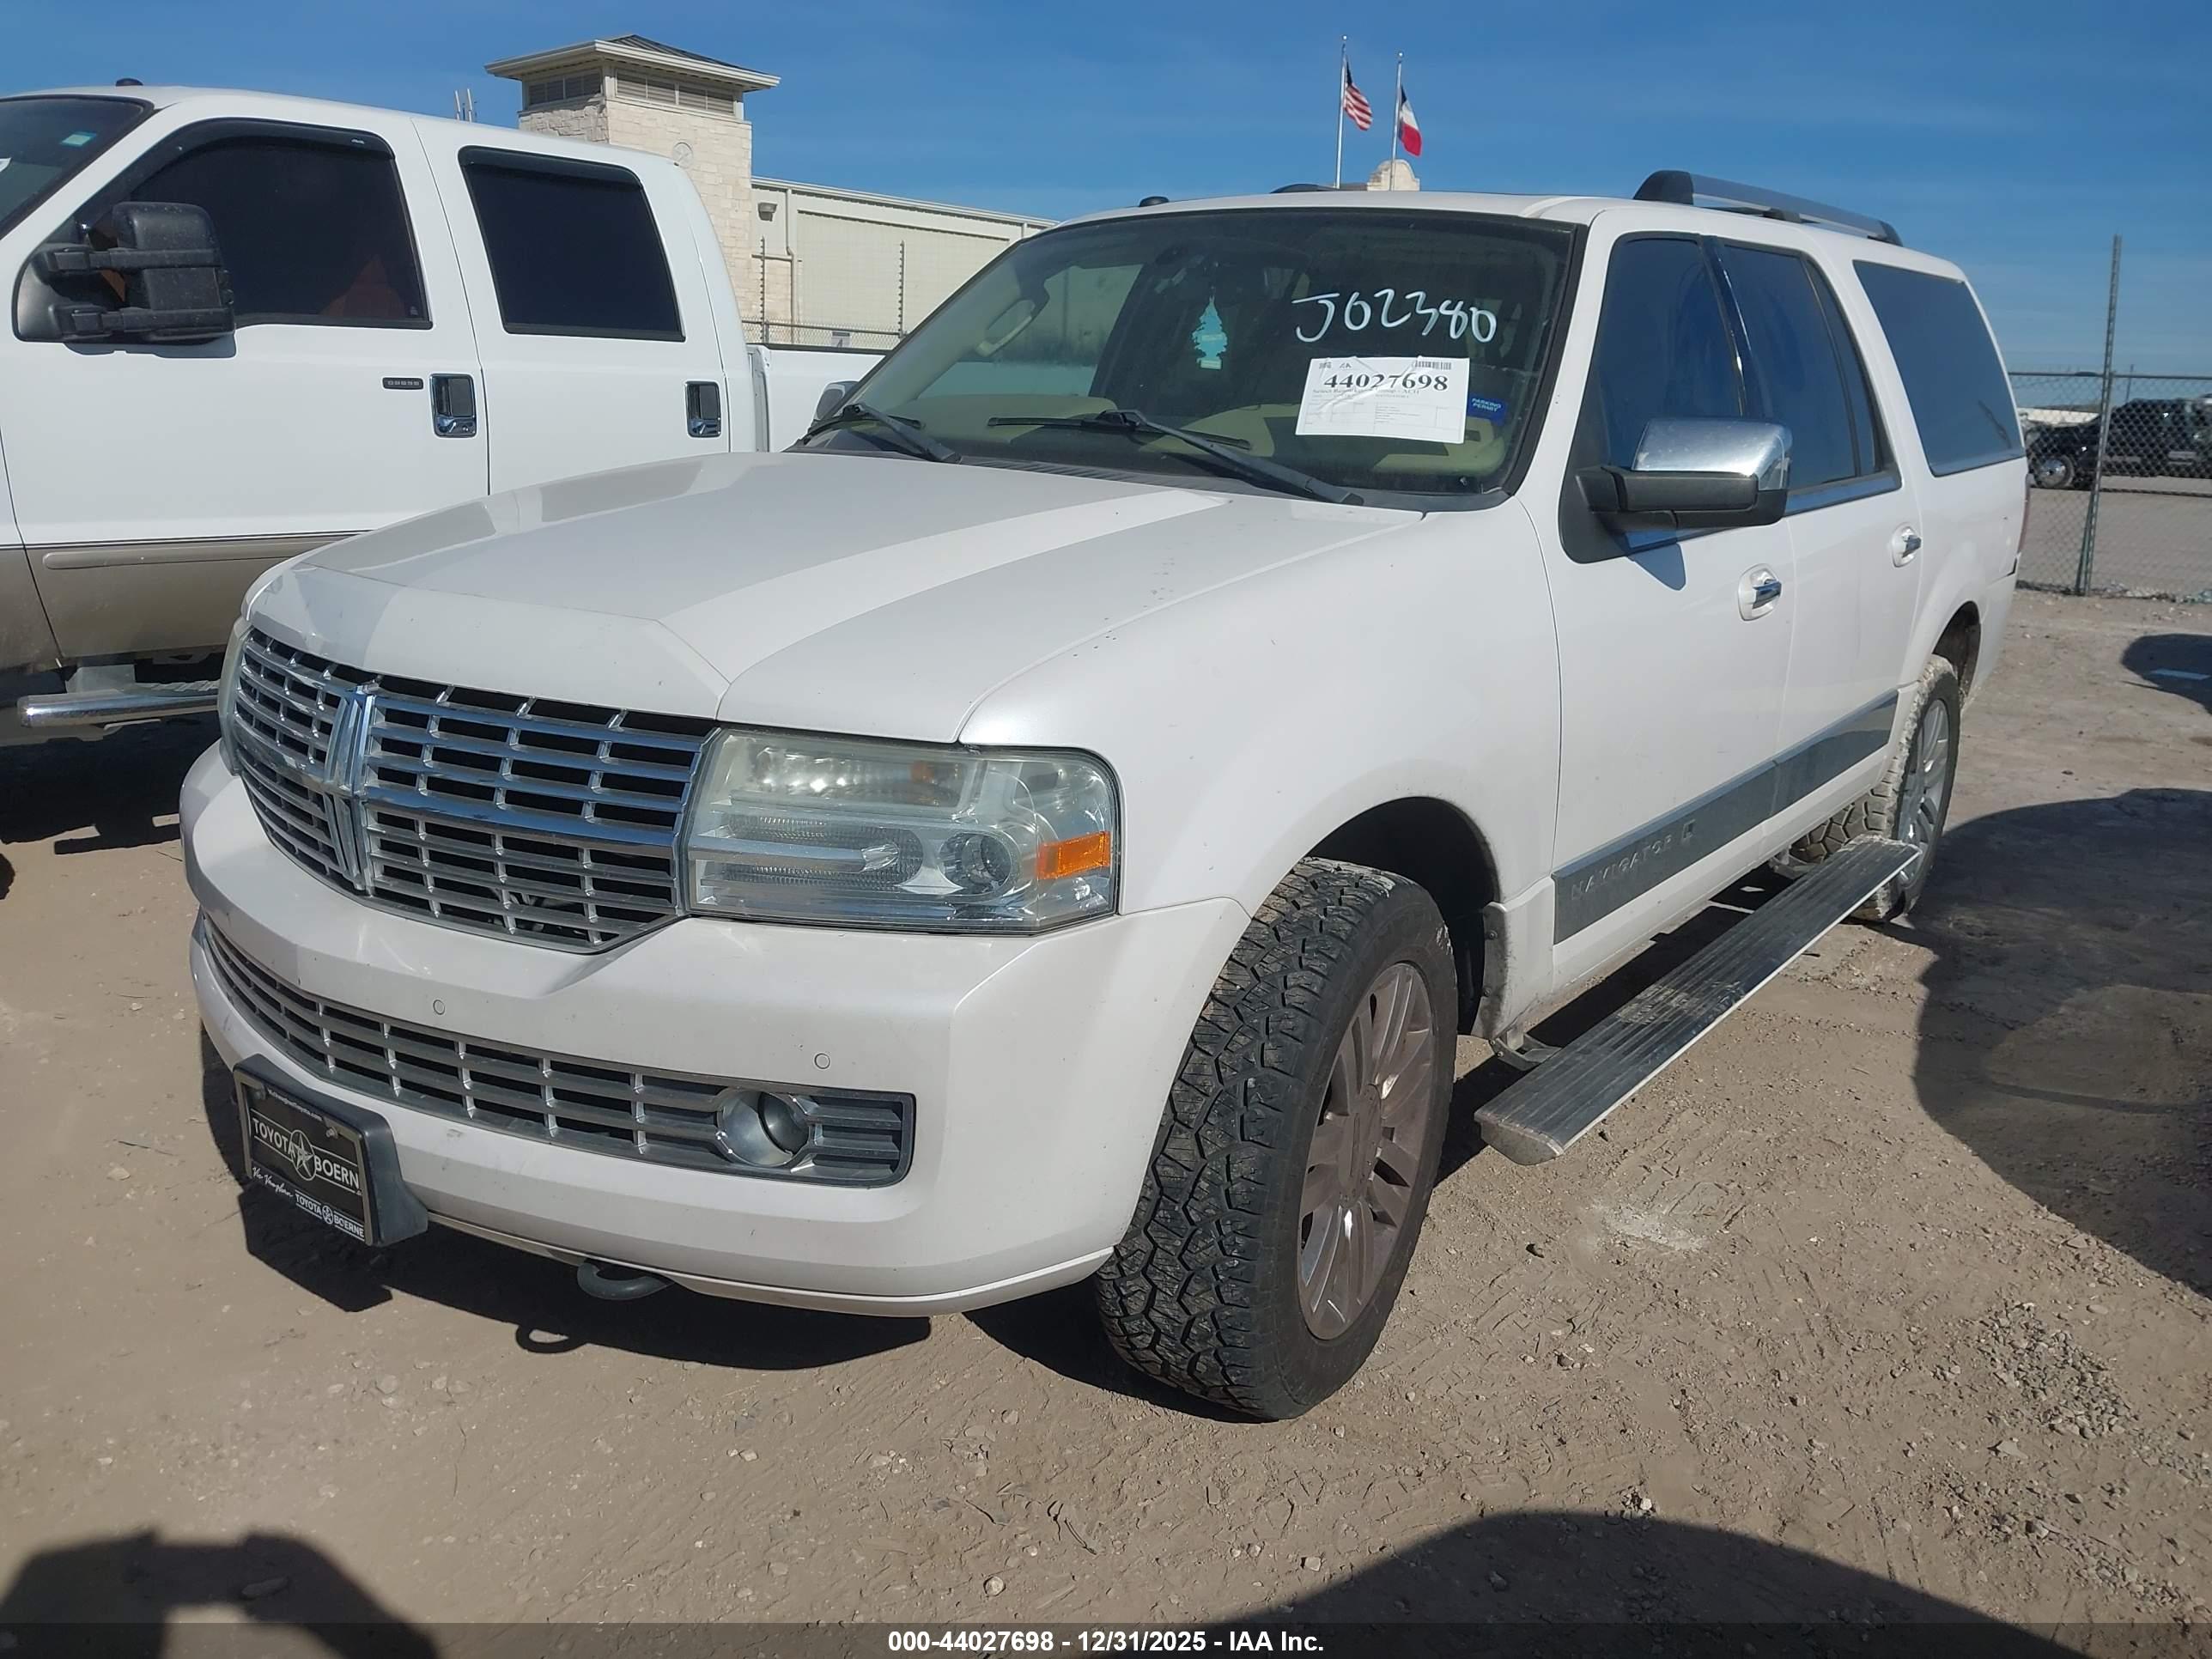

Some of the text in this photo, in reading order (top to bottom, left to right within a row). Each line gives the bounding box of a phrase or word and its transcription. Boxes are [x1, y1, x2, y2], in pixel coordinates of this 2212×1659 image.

[1323, 372, 1448, 391] 44027698
[1472, 398, 1501, 408] PARKING
[252, 1117, 297, 1158] TOYOTA
[295, 1193, 365, 1238] TOYOTA BOERNE
